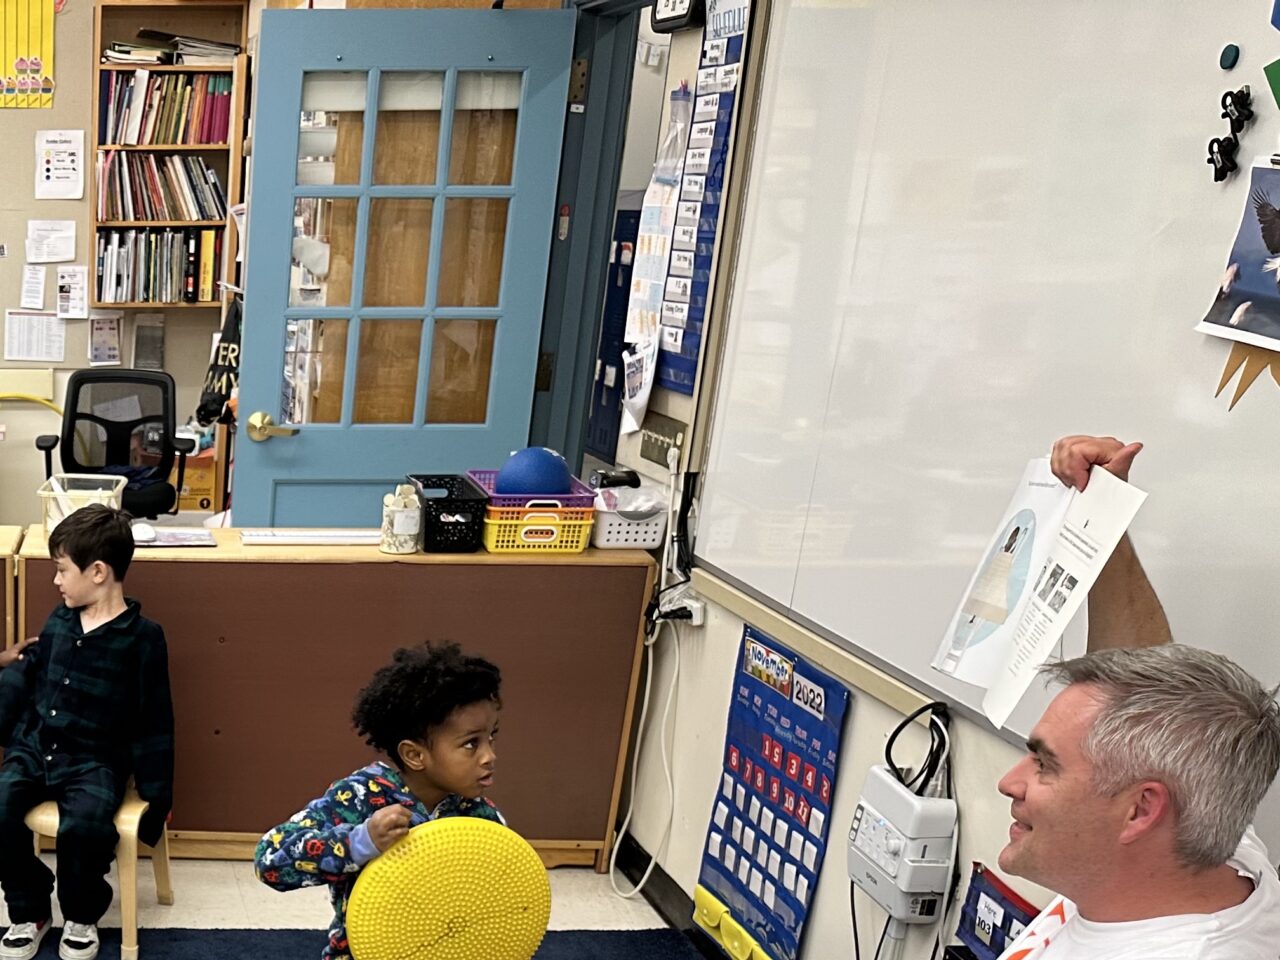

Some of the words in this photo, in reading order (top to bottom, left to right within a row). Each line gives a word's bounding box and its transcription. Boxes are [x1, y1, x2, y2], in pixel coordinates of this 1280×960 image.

[750, 645, 788, 678] November
[795, 681, 823, 715] 2022
[764, 740, 770, 756] 1
[773, 747, 780, 763] 5
[731, 752, 738, 767] 6
[789, 759, 797, 775] 3
[745, 763, 751, 778] 7
[756, 772, 762, 788] 8
[805, 771, 813, 787] 4
[772, 782, 778, 798] 9
[784, 793, 795, 811] 10
[798, 801, 807, 823] 11
[976, 915, 992, 936] 103
